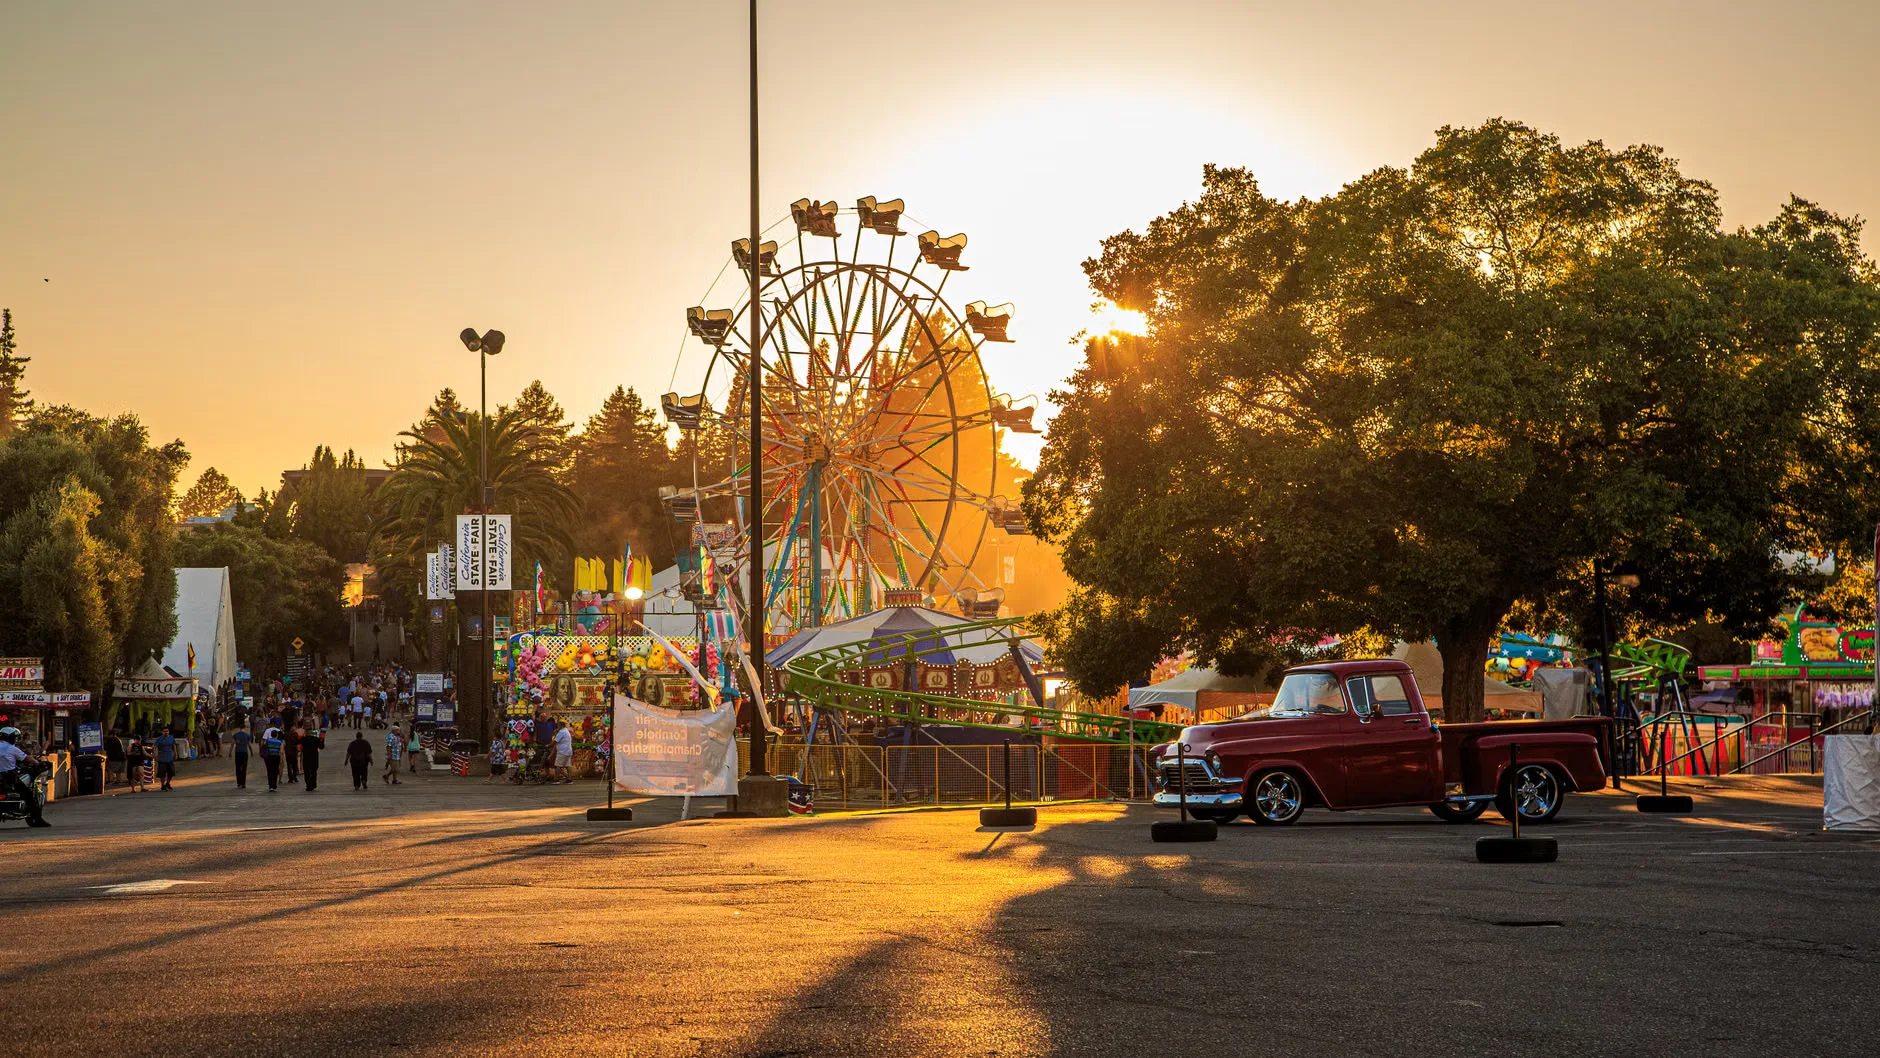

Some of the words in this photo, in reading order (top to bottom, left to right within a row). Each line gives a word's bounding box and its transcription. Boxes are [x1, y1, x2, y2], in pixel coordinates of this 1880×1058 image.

[471, 518, 479, 544] FAIR
[489, 519, 497, 554] STATE
[440, 545, 449, 591] California
[460, 523, 470, 580] California
[471, 551, 479, 586] STATE
[498, 524, 508, 581] California
[489, 560, 497, 586] FAIR
